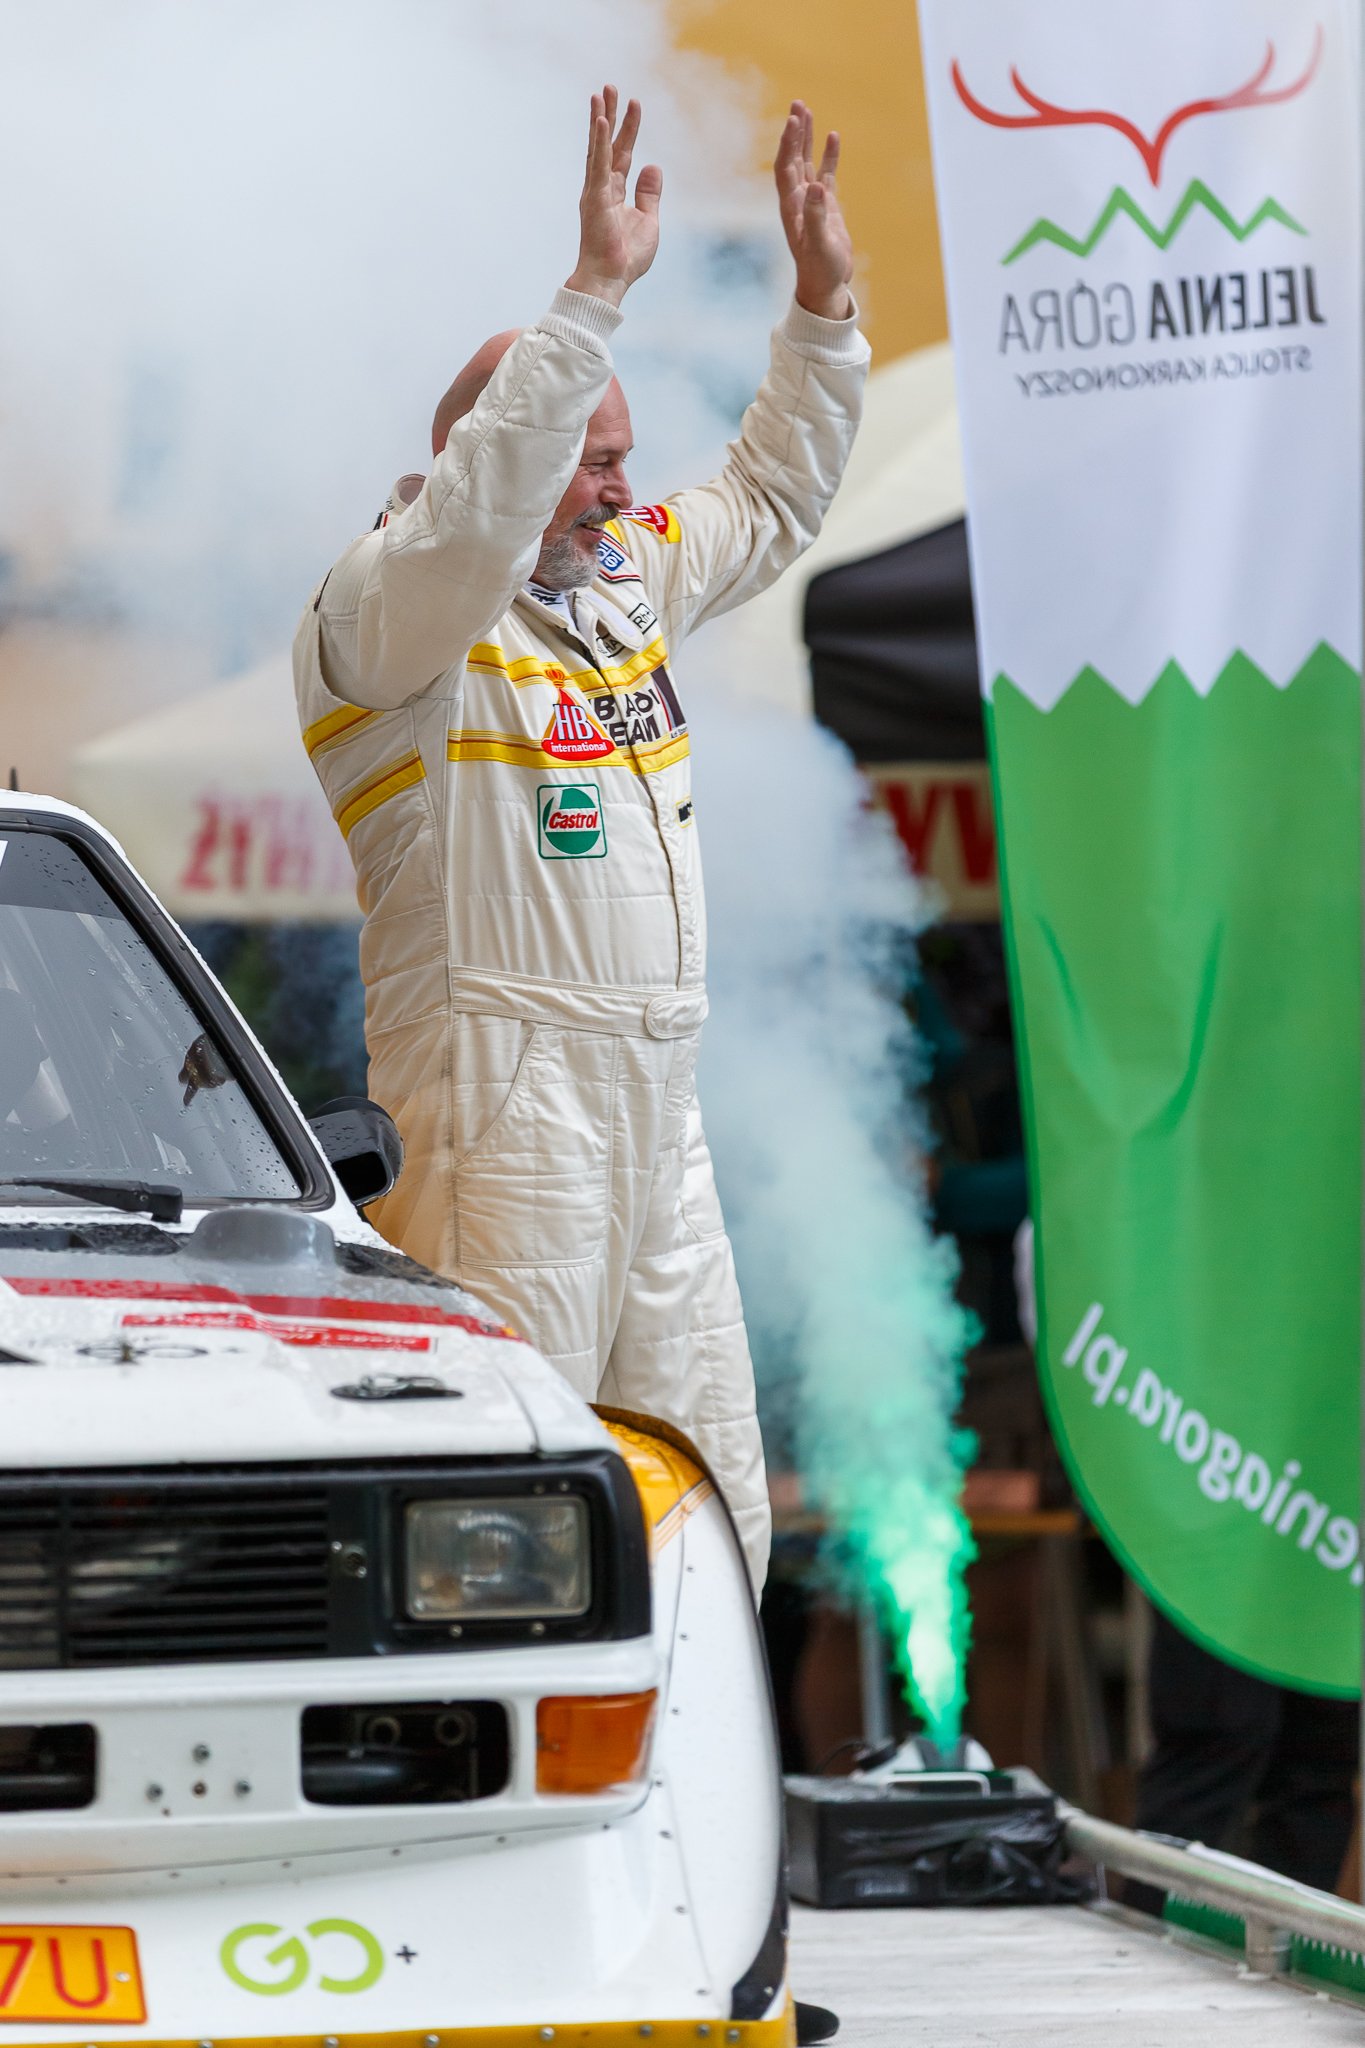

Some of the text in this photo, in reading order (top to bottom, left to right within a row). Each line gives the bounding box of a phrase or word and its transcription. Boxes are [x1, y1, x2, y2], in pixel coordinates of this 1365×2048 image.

[588, 688, 661, 721] B ADI
[553, 704, 595, 741] HB
[603, 713, 661, 747] EAM
[550, 741, 608, 753] international
[548, 810, 598, 830] Castrol
